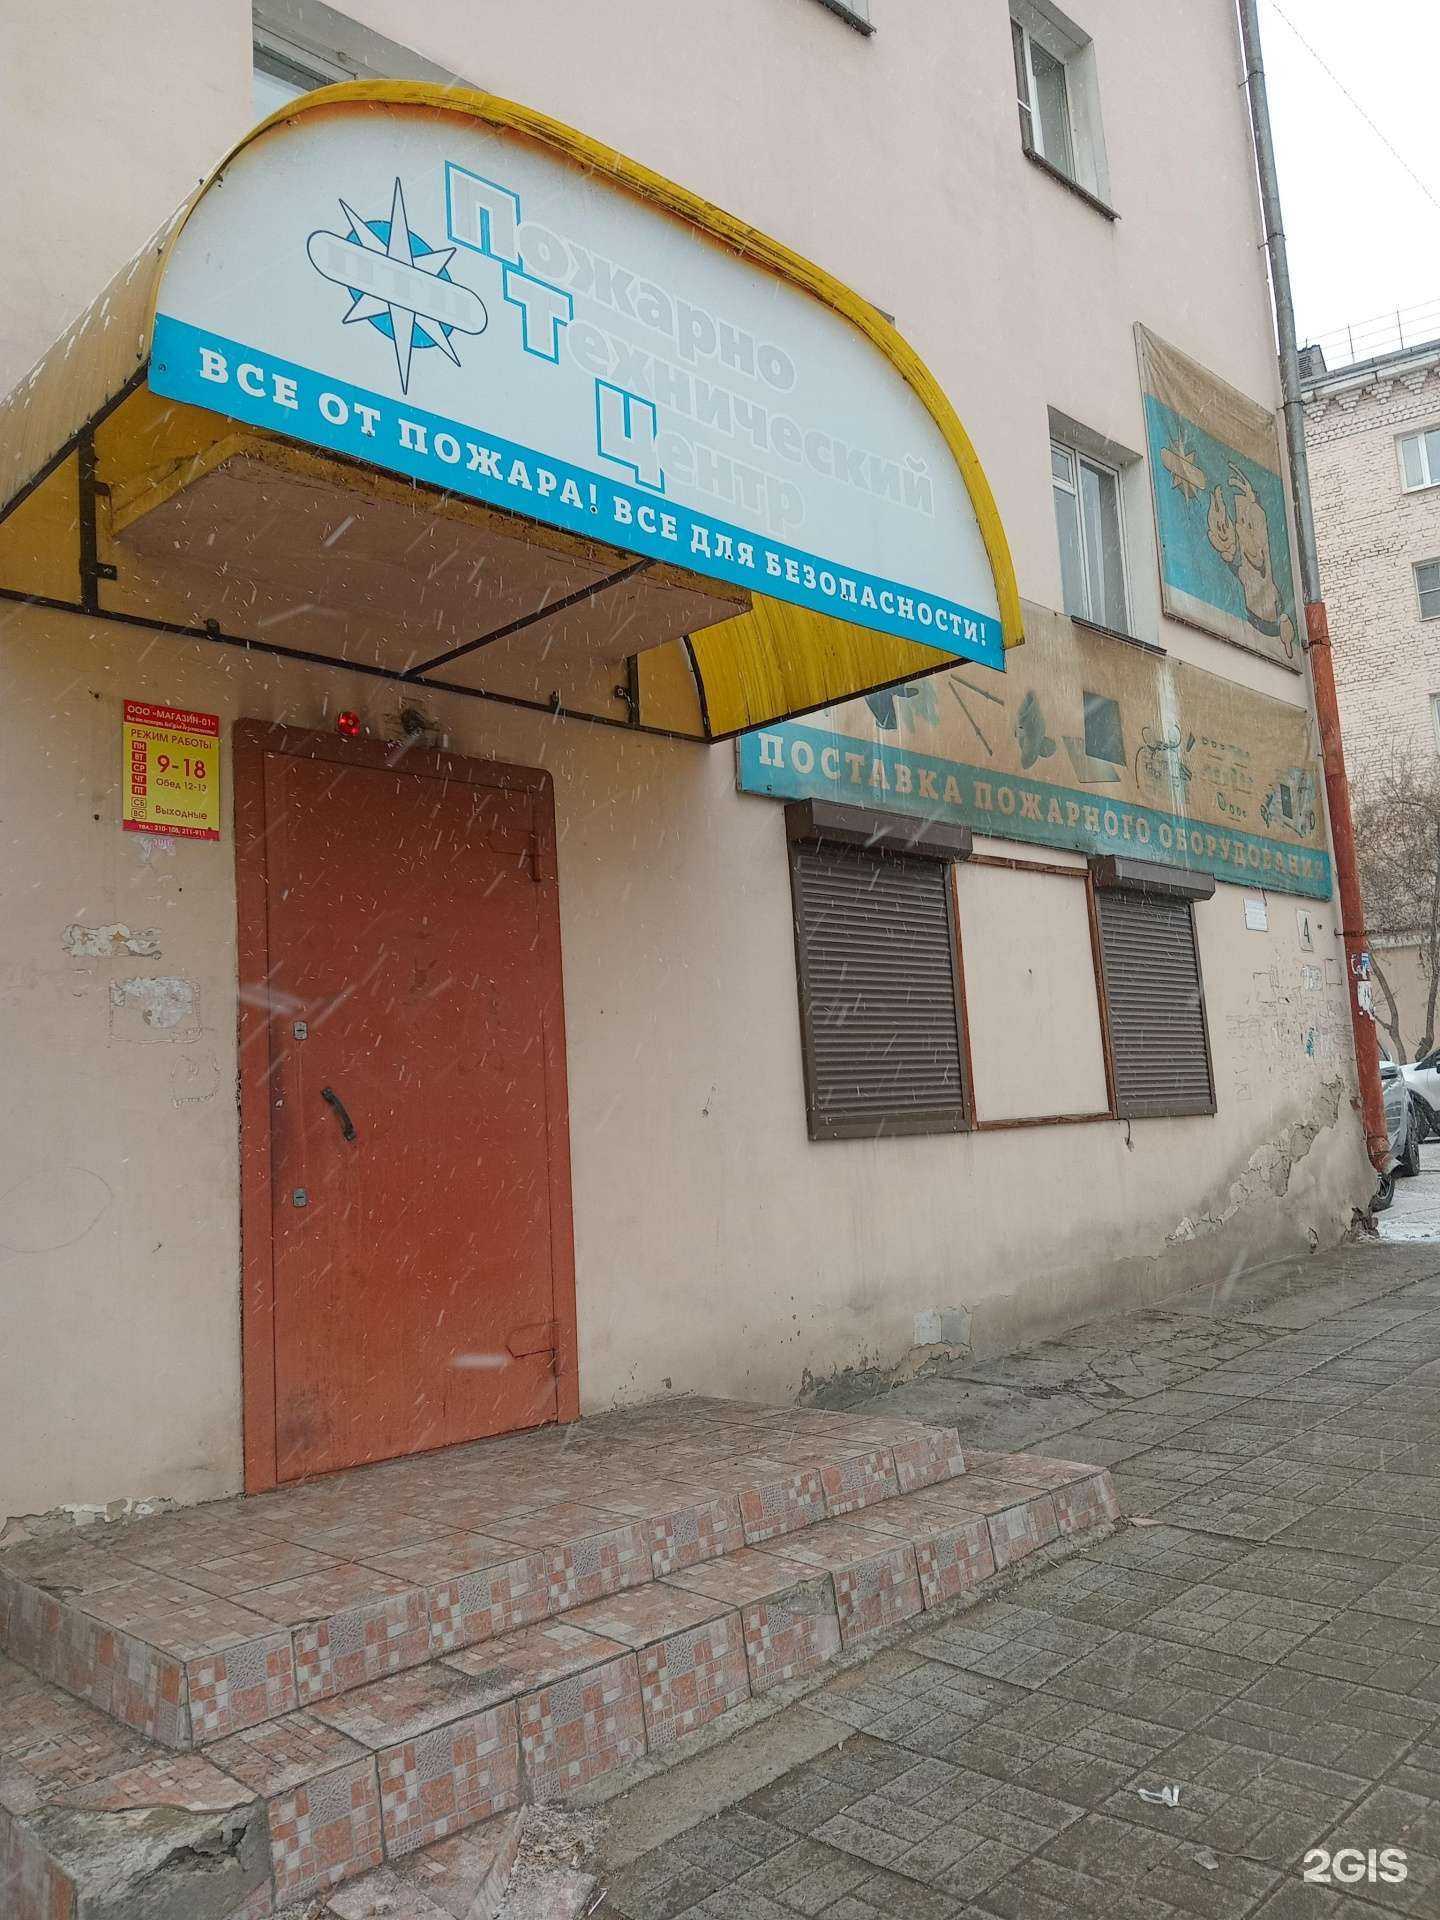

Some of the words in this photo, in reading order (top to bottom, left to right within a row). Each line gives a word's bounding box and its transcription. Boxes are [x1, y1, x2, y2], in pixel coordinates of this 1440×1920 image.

[445, 160, 797, 394] Пожарно
[502, 263, 936, 519] Технический
[199, 346, 299, 410] ВСЕ
[318, 392, 381, 437] ОТ
[398, 417, 600, 514] ПОЖАРА!
[612, 495, 679, 542] ВСЕ
[690, 522, 755, 569] ДЛЯ
[764, 550, 988, 647] БЕЗОПАСНОСТИ!
[595, 377, 808, 539] Центр
[131, 728, 169, 744] РЕЖИМ
[171, 735, 213, 750] РАБОТЫ
[155, 777, 181, 791] Обед
[157, 754, 206, 780] 9-18
[758, 731, 965, 805] ПОСТАВКА
[972, 780, 1152, 845] ПОЖАРНОГО
[155, 804, 208, 820] Выходные
